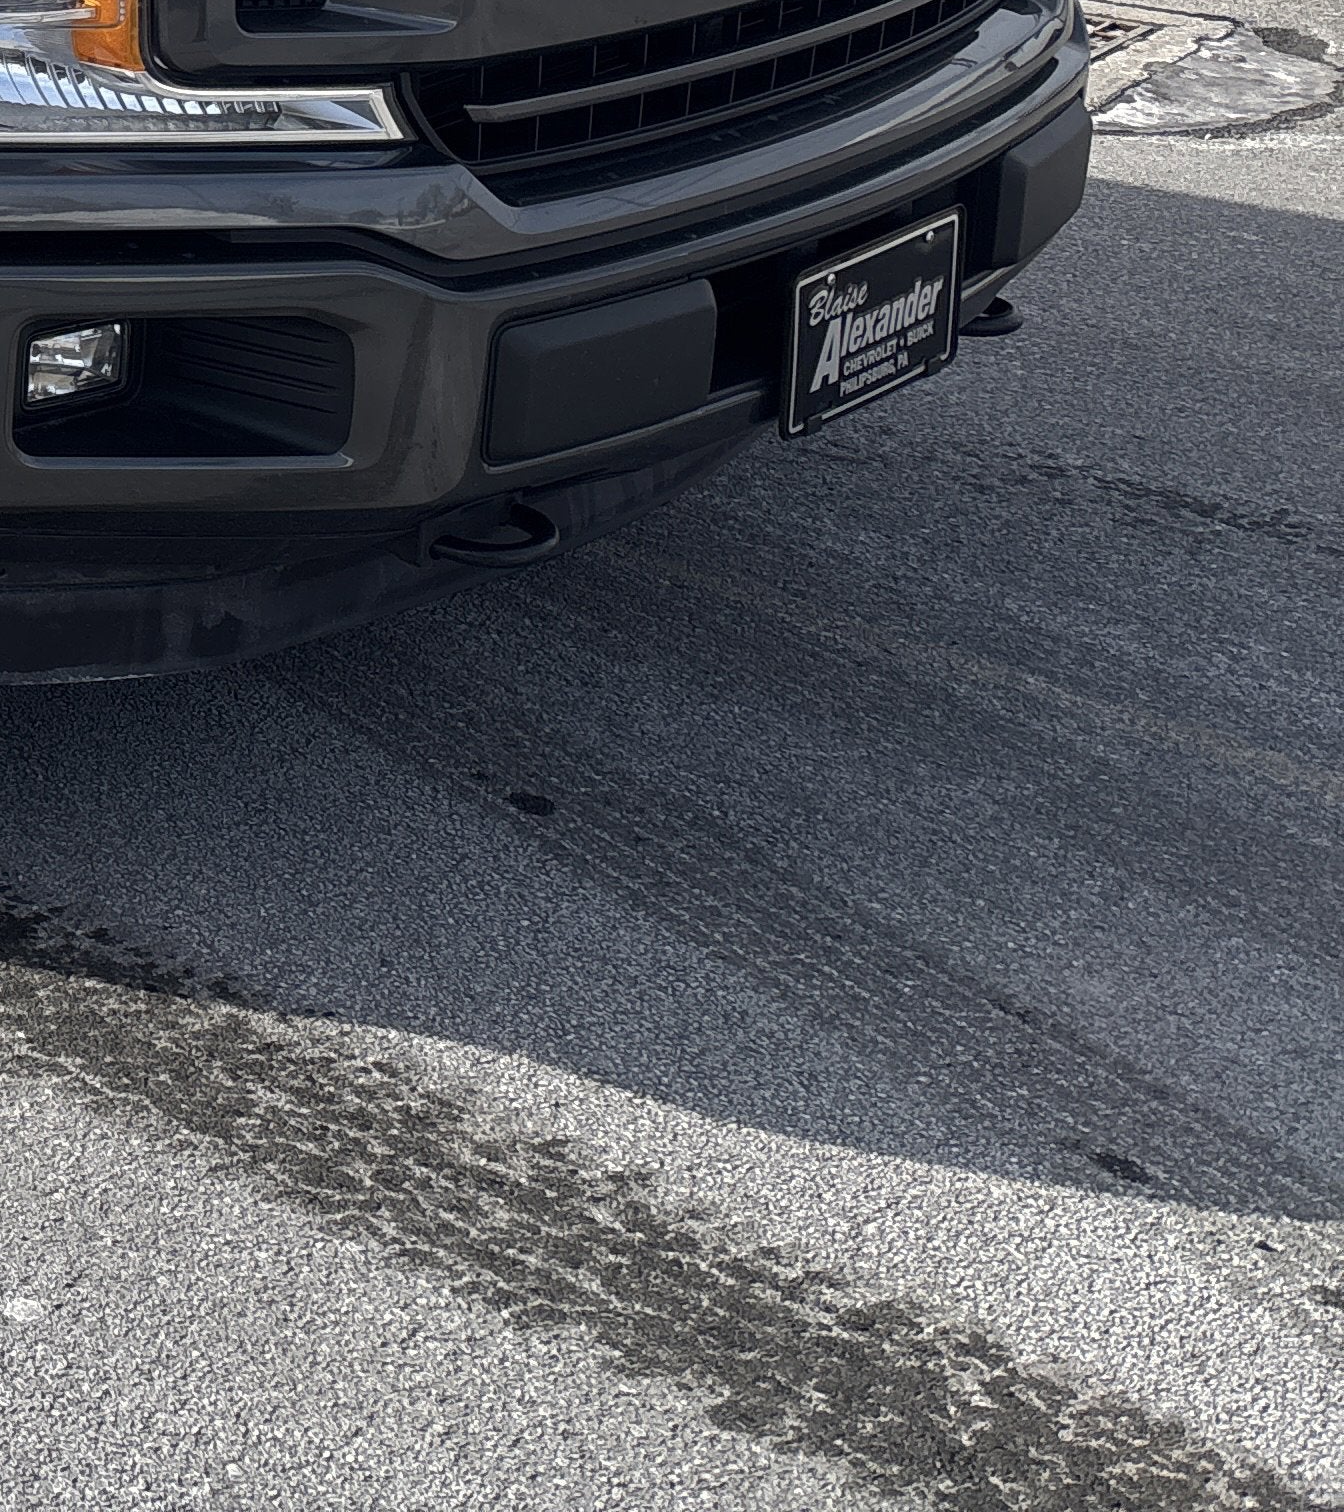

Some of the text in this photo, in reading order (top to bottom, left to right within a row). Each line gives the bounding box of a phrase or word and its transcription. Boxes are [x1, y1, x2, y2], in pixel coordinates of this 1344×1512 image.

[809, 283, 868, 326] Blaise
[809, 278, 944, 393] Alexander
[844, 339, 897, 376] CHEVROLET
